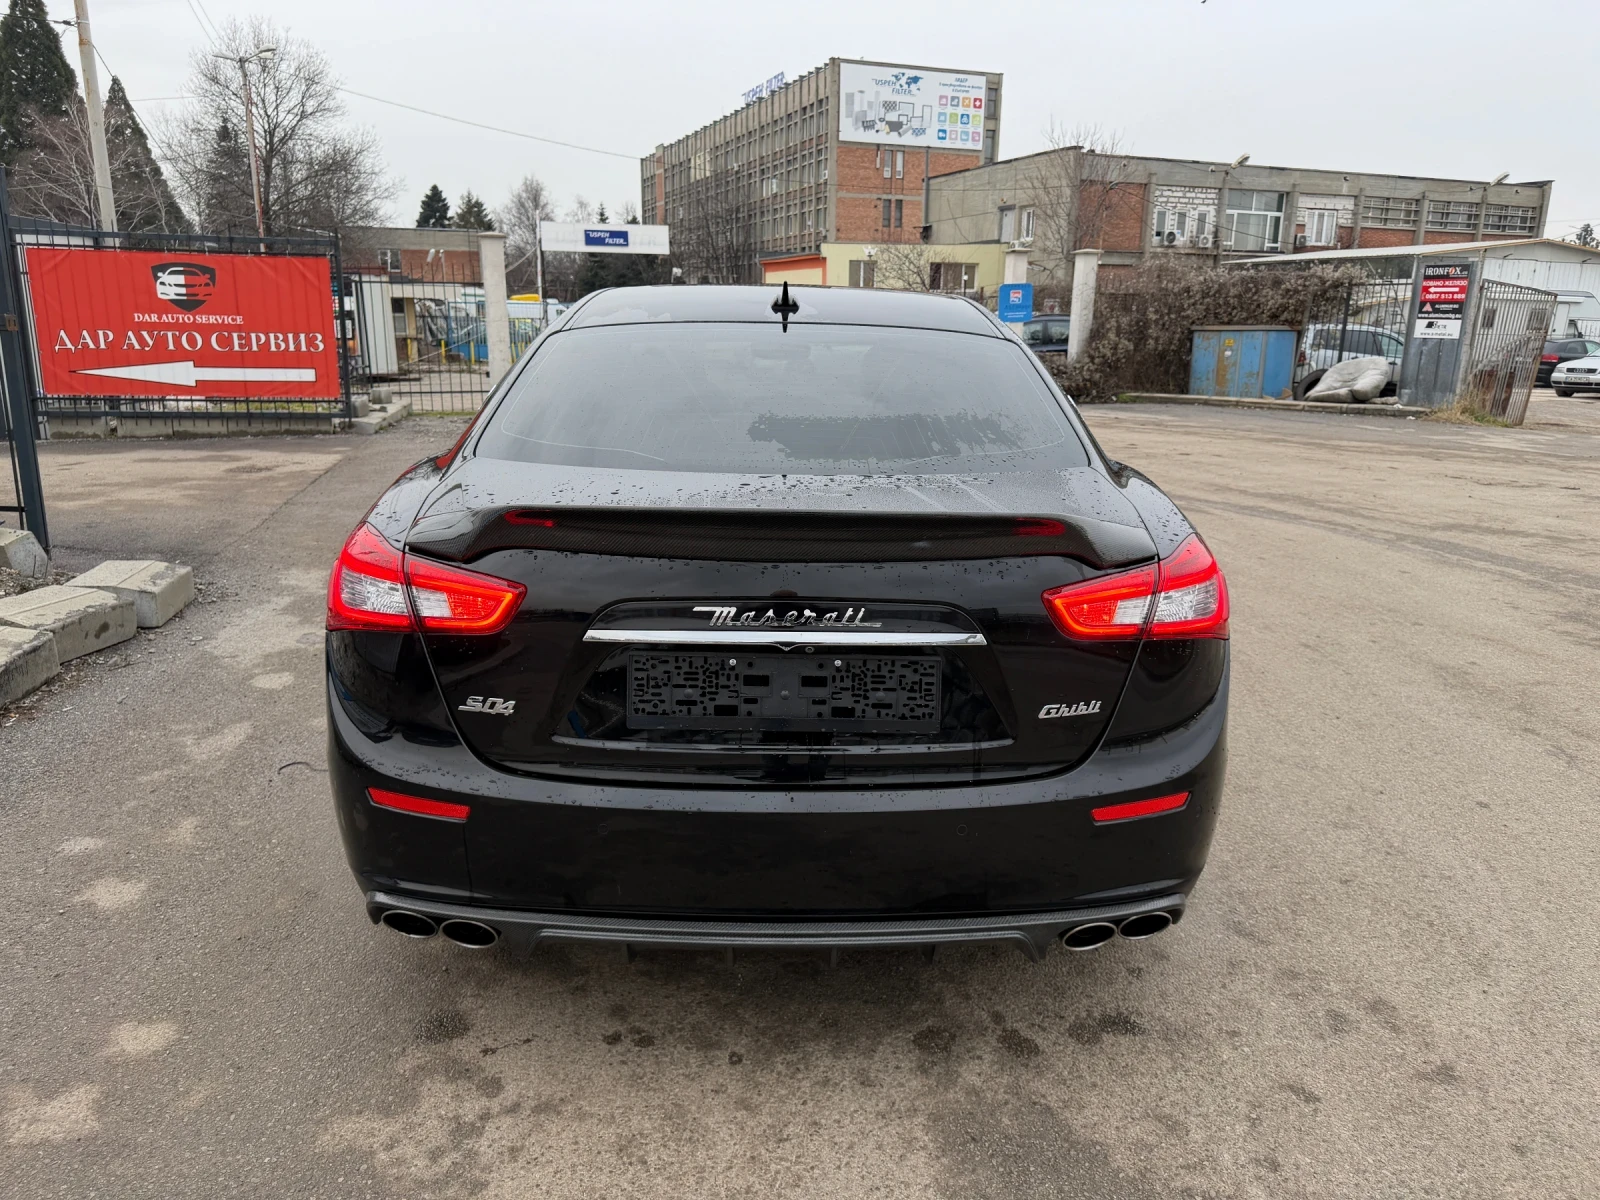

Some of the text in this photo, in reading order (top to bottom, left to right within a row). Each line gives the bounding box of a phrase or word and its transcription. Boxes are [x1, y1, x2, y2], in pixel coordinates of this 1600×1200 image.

[133, 313, 244, 324] DAR AUTO SERVICE
[54, 329, 325, 354] ДАР АУТО СЕРВИЗ
[692, 606, 882, 627] Maserati
[1038, 700, 1102, 719] Ghibli
